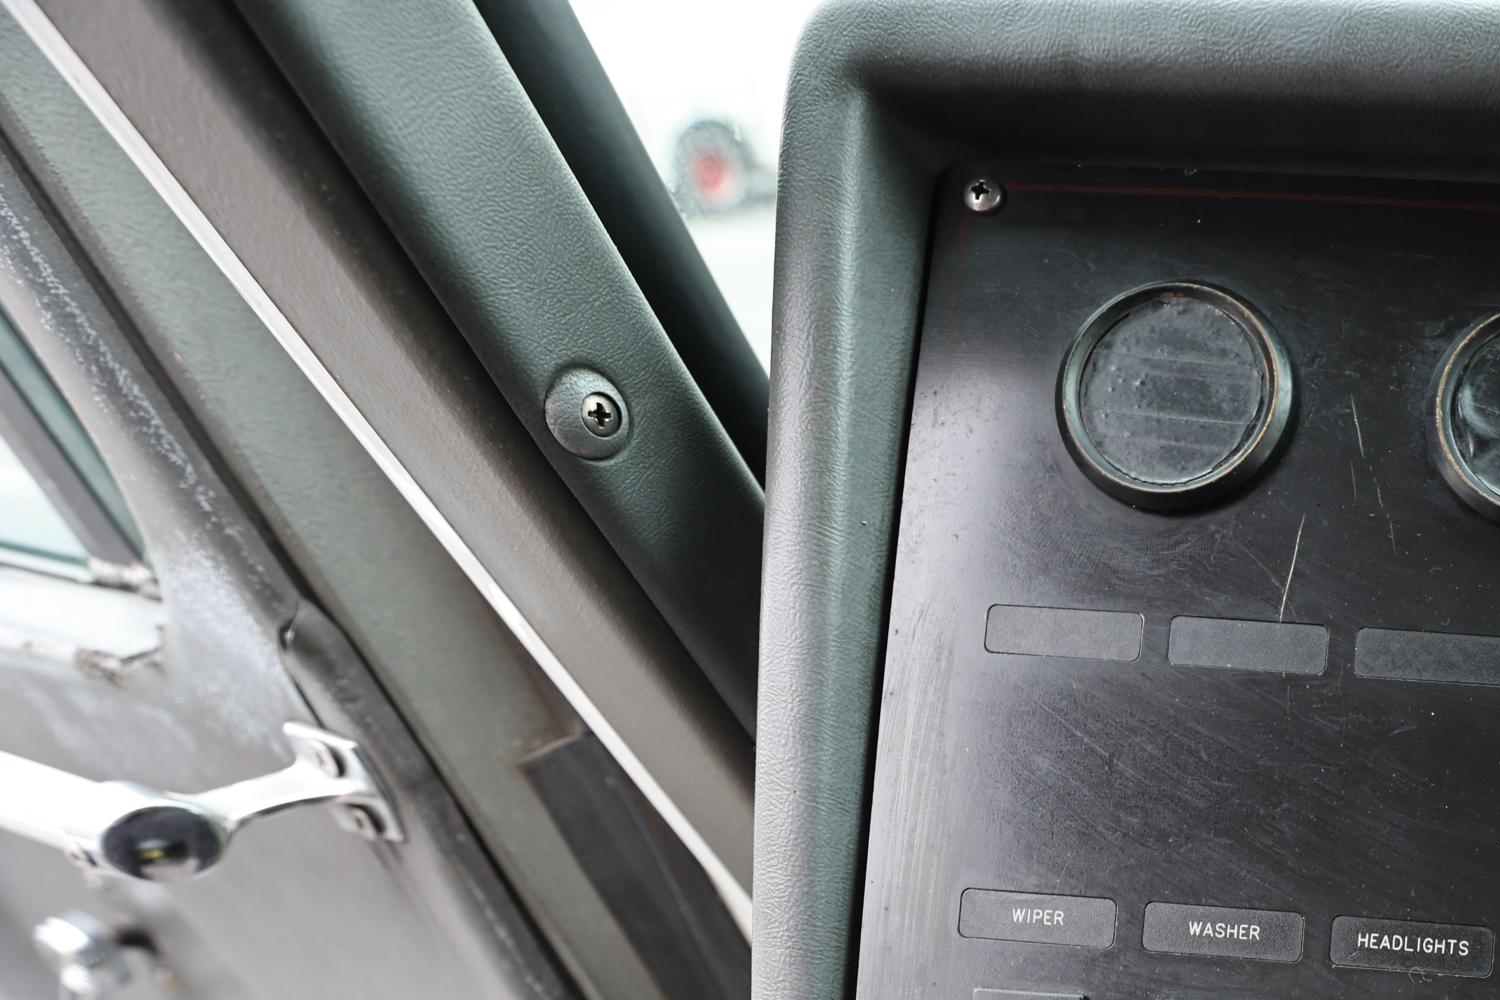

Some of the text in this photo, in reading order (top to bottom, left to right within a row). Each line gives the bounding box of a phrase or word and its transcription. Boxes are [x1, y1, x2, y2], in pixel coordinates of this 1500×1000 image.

[1012, 908, 1065, 926] WIPER
[1188, 921, 1261, 941] WASHER
[1357, 932, 1470, 957] HEADLIGHTS
